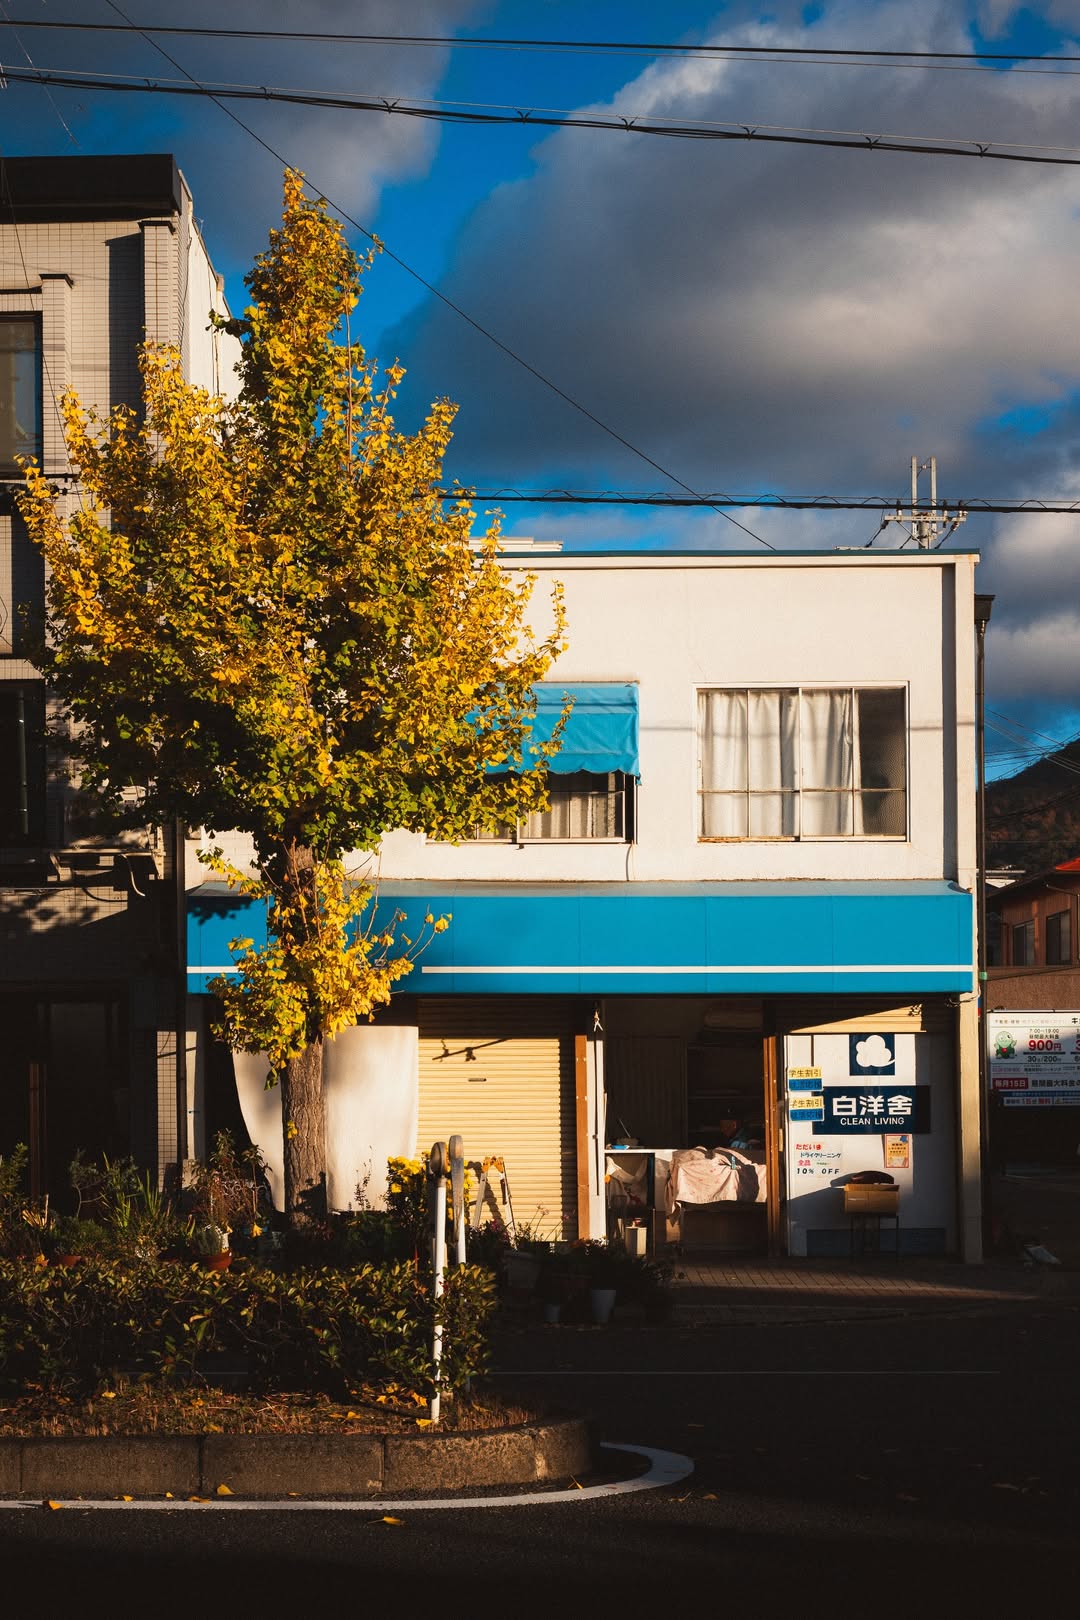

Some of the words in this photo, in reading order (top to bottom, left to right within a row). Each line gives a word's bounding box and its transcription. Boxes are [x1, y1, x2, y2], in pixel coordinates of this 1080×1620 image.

[1028, 1040, 1062, 1051] 900円
[832, 1094, 913, 1116] 白洋舎
[840, 1117, 871, 1126] CLEAN
[874, 1117, 905, 1125] LIVING
[795, 1143, 822, 1151] ただいま
